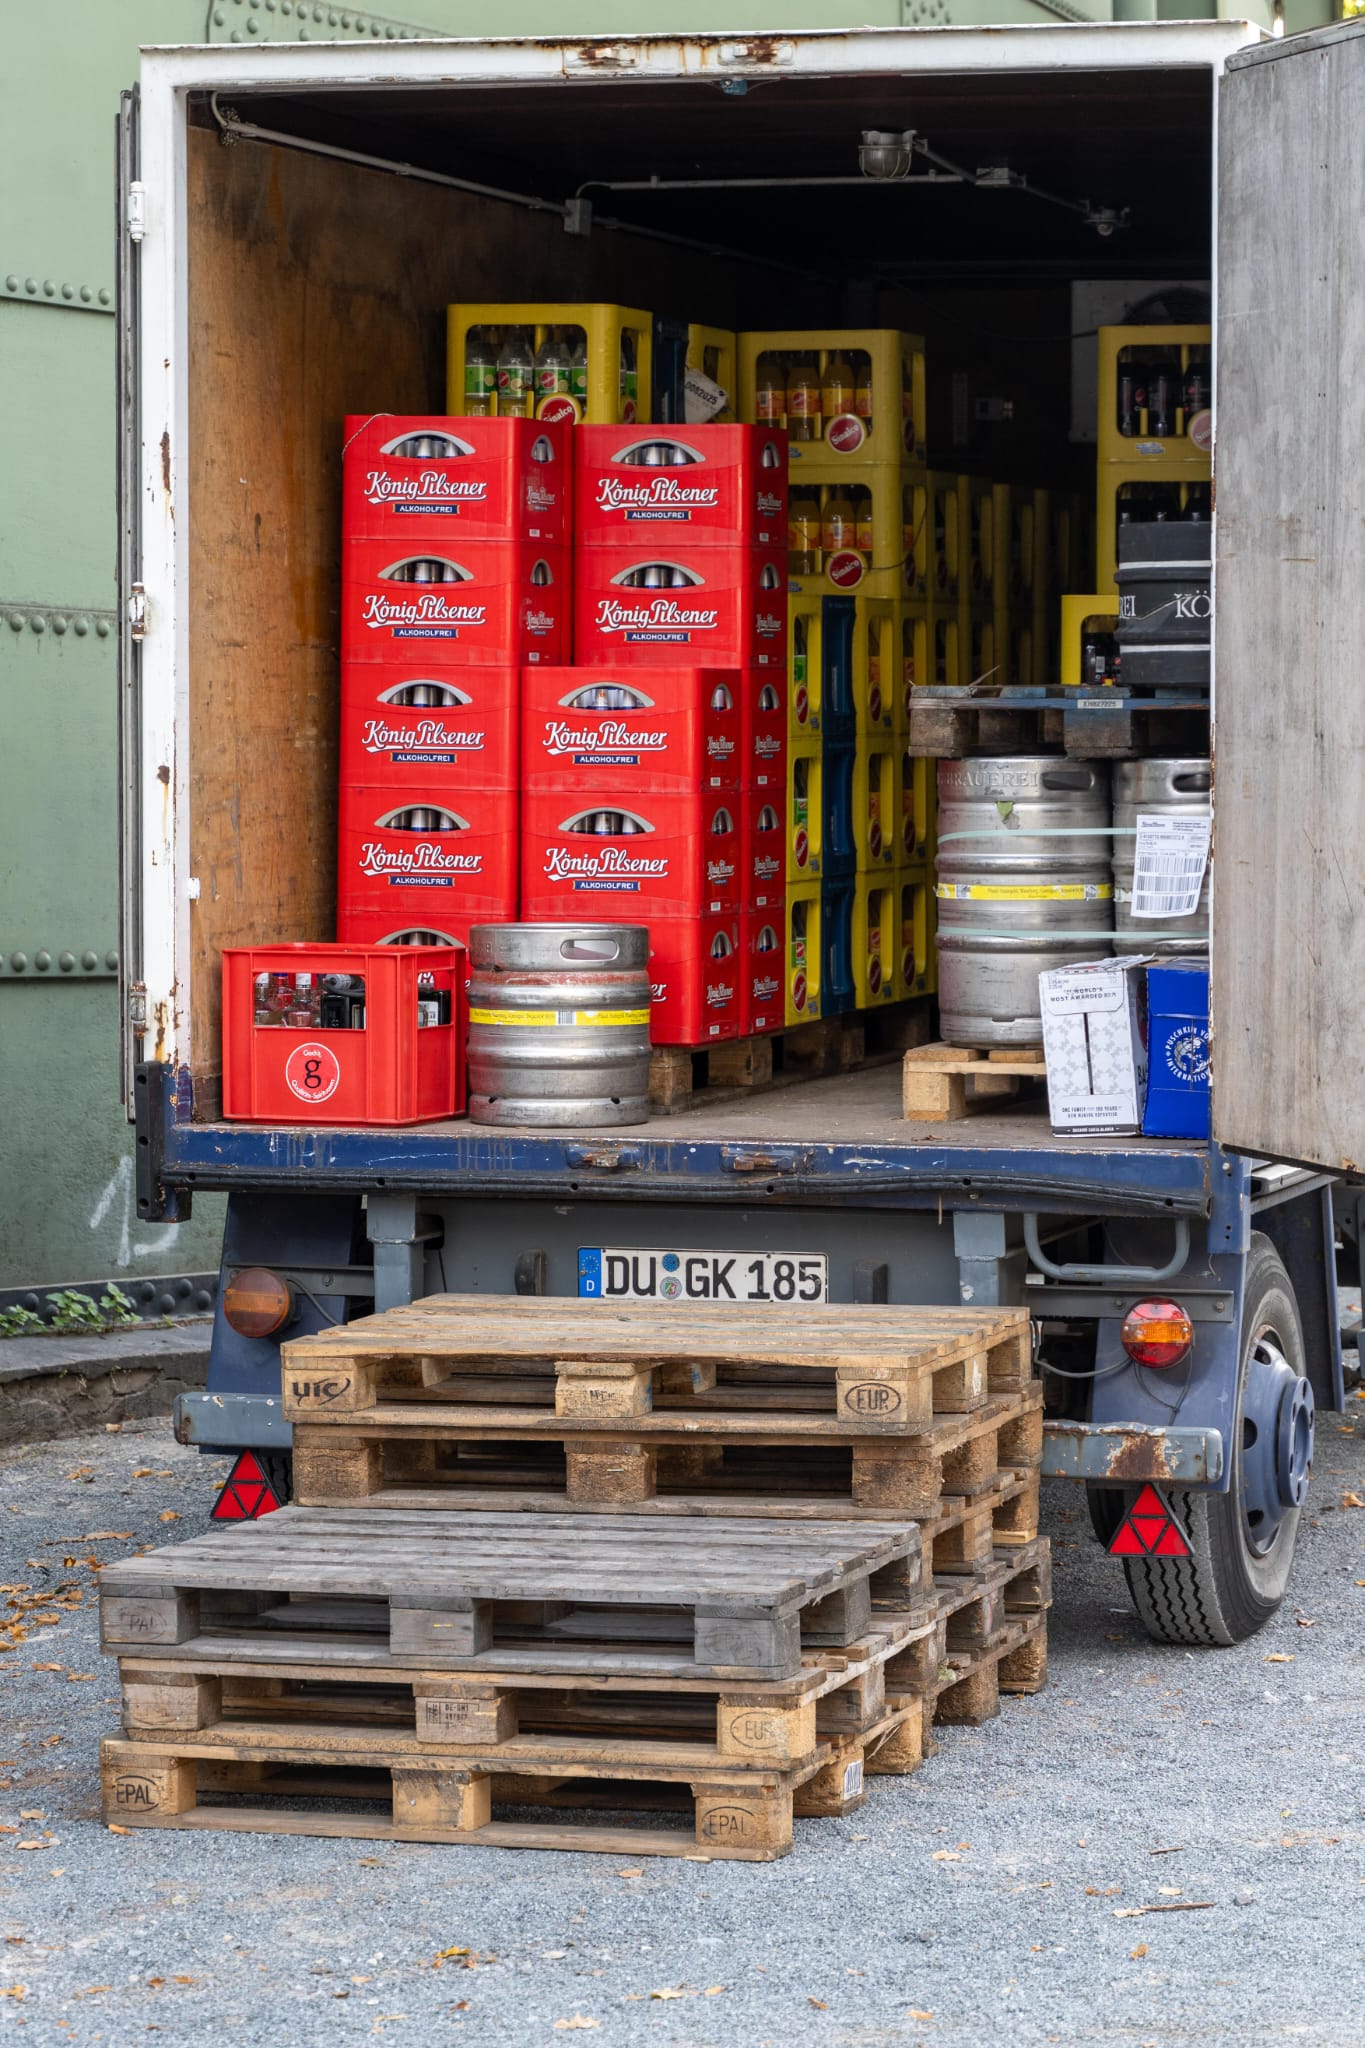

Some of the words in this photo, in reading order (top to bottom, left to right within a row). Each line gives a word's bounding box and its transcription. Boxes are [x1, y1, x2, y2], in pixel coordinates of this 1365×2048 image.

[364, 471, 418, 499] König
[418, 471, 487, 496] Pilsener
[595, 478, 650, 507] König
[649, 477, 718, 502] Pilsener
[400, 505, 453, 513] ALKOHOLFREI
[632, 511, 685, 519] ALKOHOLFREI
[362, 595, 416, 623] König
[415, 594, 486, 620] Pilsener
[595, 600, 650, 628] König
[649, 600, 718, 624] Pilsener
[398, 629, 452, 637] ALKOHOLFREI
[632, 633, 684, 641] ALKOHOLFREI
[361, 720, 416, 748] König
[415, 720, 484, 745] Pilsener
[542, 721, 599, 750] König
[598, 721, 667, 746] Pilsener
[397, 754, 450, 762] ALKOHOLFREI
[359, 843, 414, 871] König
[412, 843, 482, 868] Pilsener
[543, 848, 600, 876] König
[598, 847, 668, 873] Pilsener
[395, 877, 448, 885] ALKOHOLFREI
[1165, 1026, 1198, 1050] PUSCHKIN
[304, 1059, 321, 1089] g
[586, 1280, 595, 1291] D
[605, 1255, 656, 1296] DU
[685, 1258, 736, 1298] GK
[747, 1260, 822, 1300] 185
[857, 1389, 889, 1411] EUR
[114, 1783, 154, 1804] EPAL
[708, 1813, 750, 1836] EPAL
